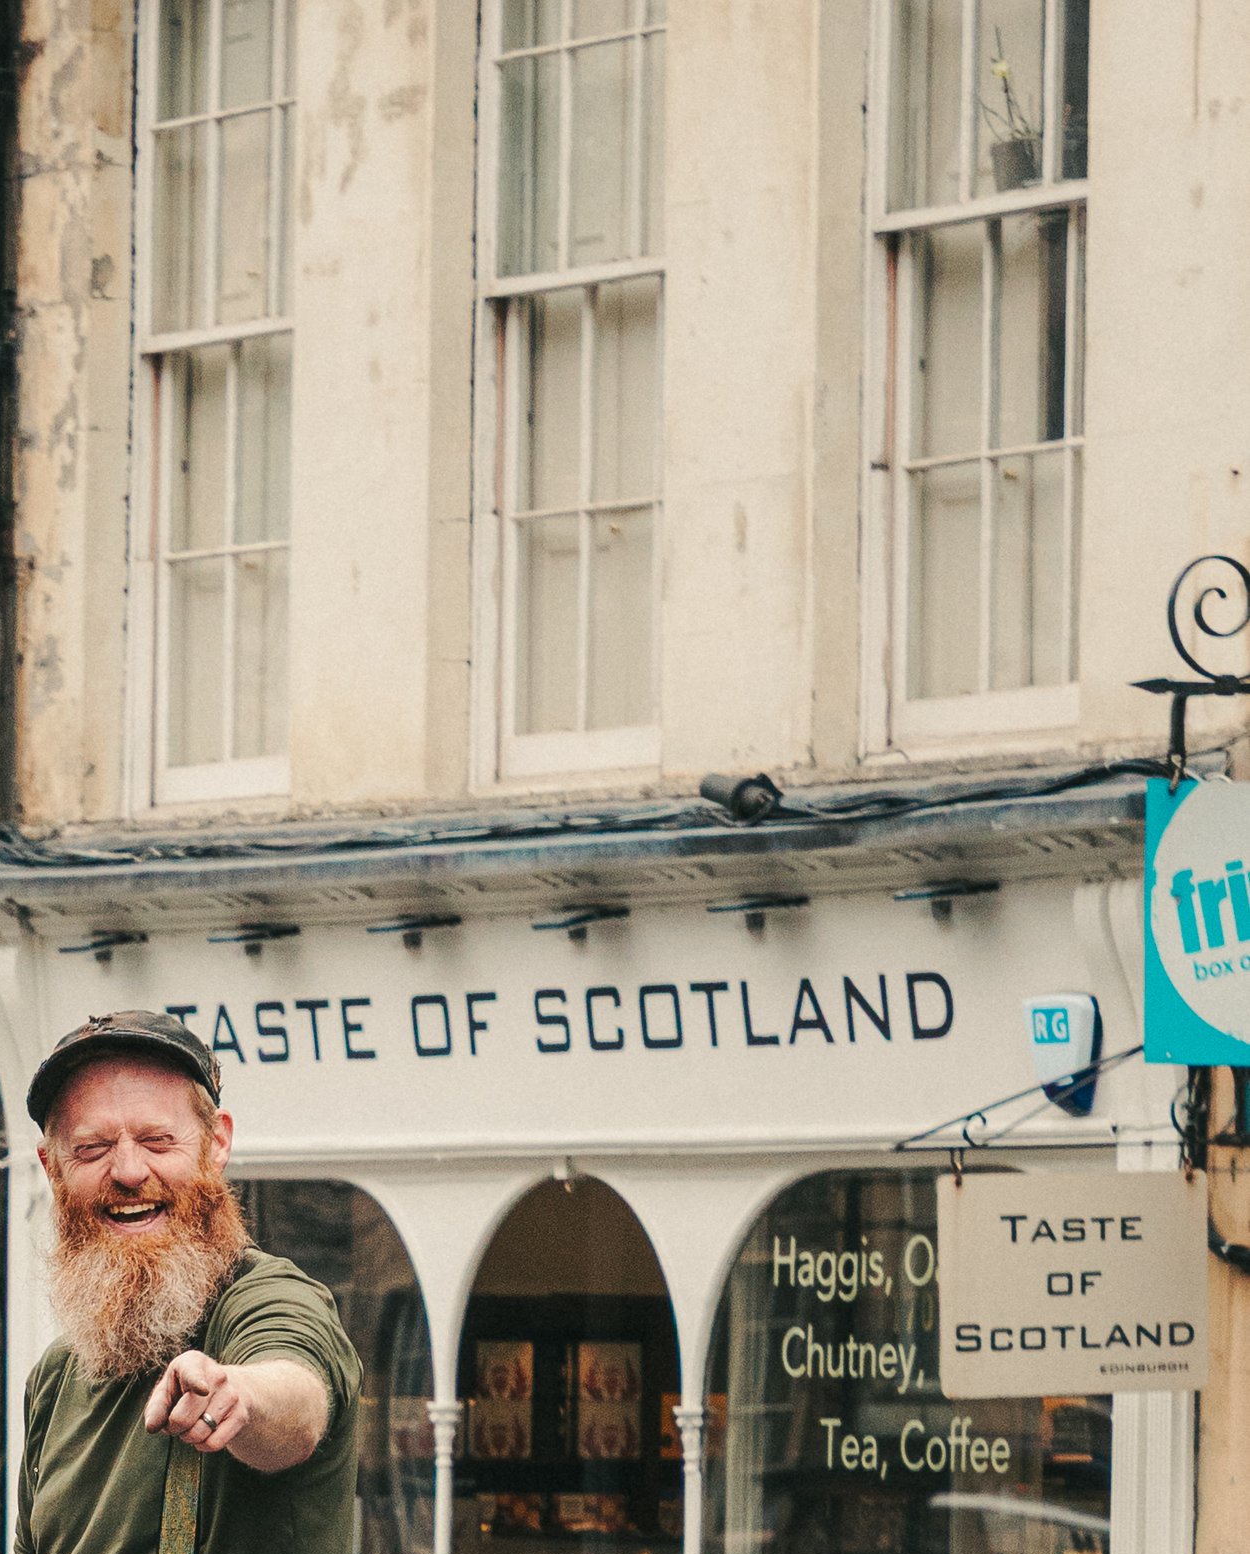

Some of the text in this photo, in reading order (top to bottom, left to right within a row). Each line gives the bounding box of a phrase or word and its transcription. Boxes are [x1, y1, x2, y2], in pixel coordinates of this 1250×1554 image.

[1171, 860, 1250, 954] fri
[1193, 959, 1234, 981] box
[411, 992, 498, 1057] OF
[534, 972, 955, 1053] SCOTLAND
[773, 1235, 892, 1302] Haggis,
[1047, 1271, 1103, 1296] OF
[782, 1323, 924, 1394] Chutney,
[1100, 1362, 1190, 1376] EDINBURGH
[819, 1416, 1011, 1480] Tea, Coffee
